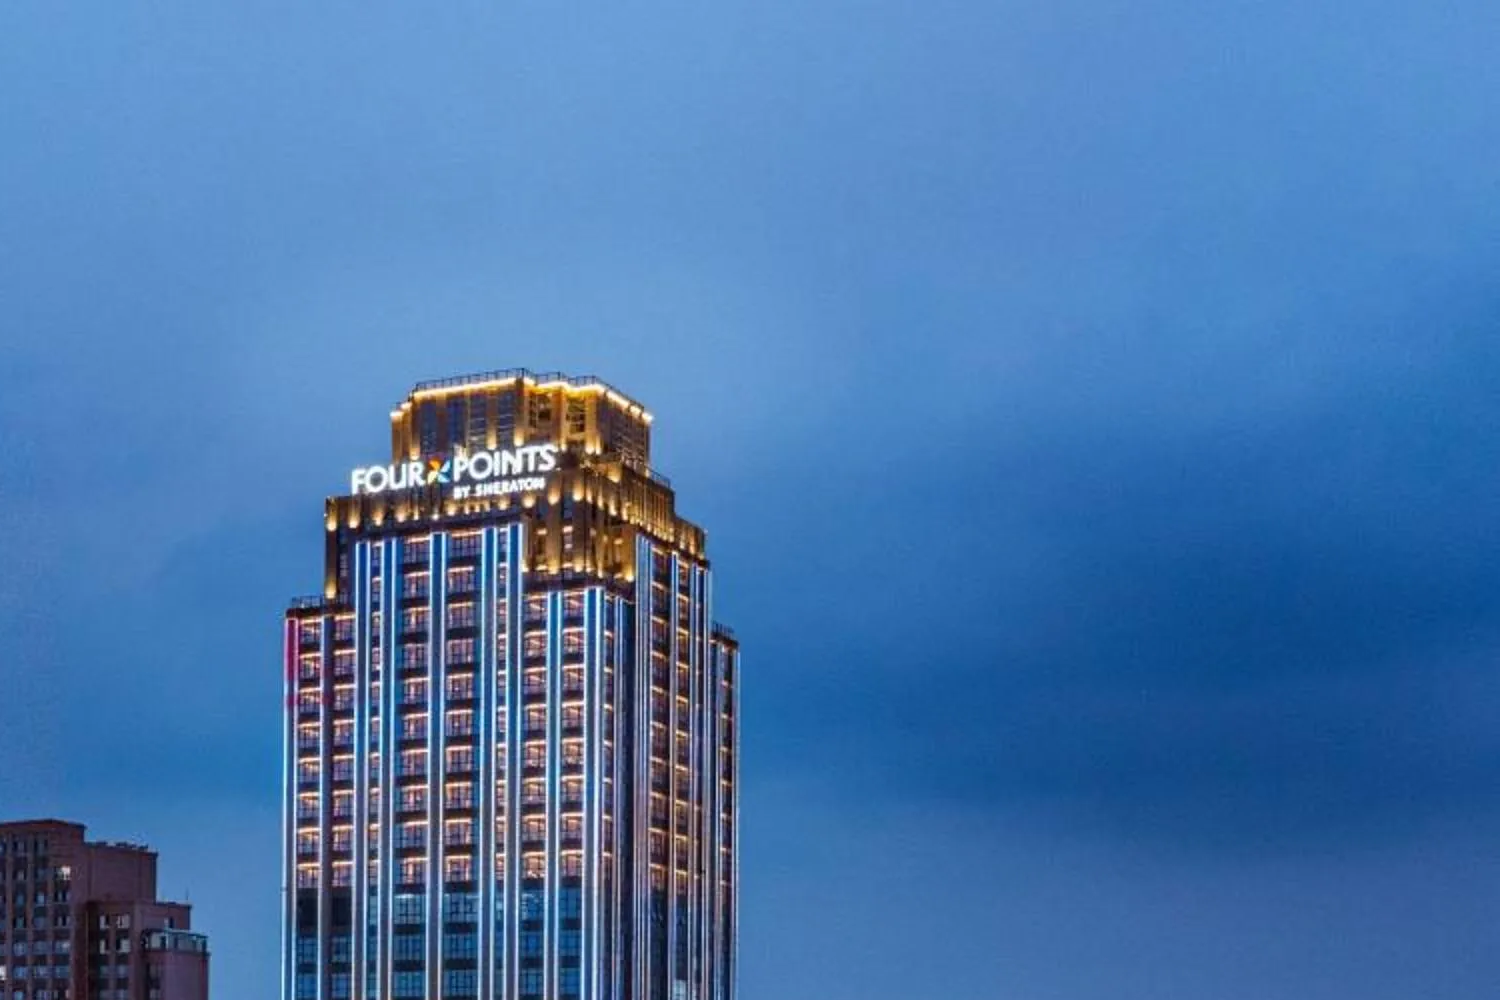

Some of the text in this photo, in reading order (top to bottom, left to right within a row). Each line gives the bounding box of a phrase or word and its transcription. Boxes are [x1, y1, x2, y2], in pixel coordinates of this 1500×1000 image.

[351, 445, 557, 495] FOUR POINTS
[475, 477, 545, 496] SHERATON
